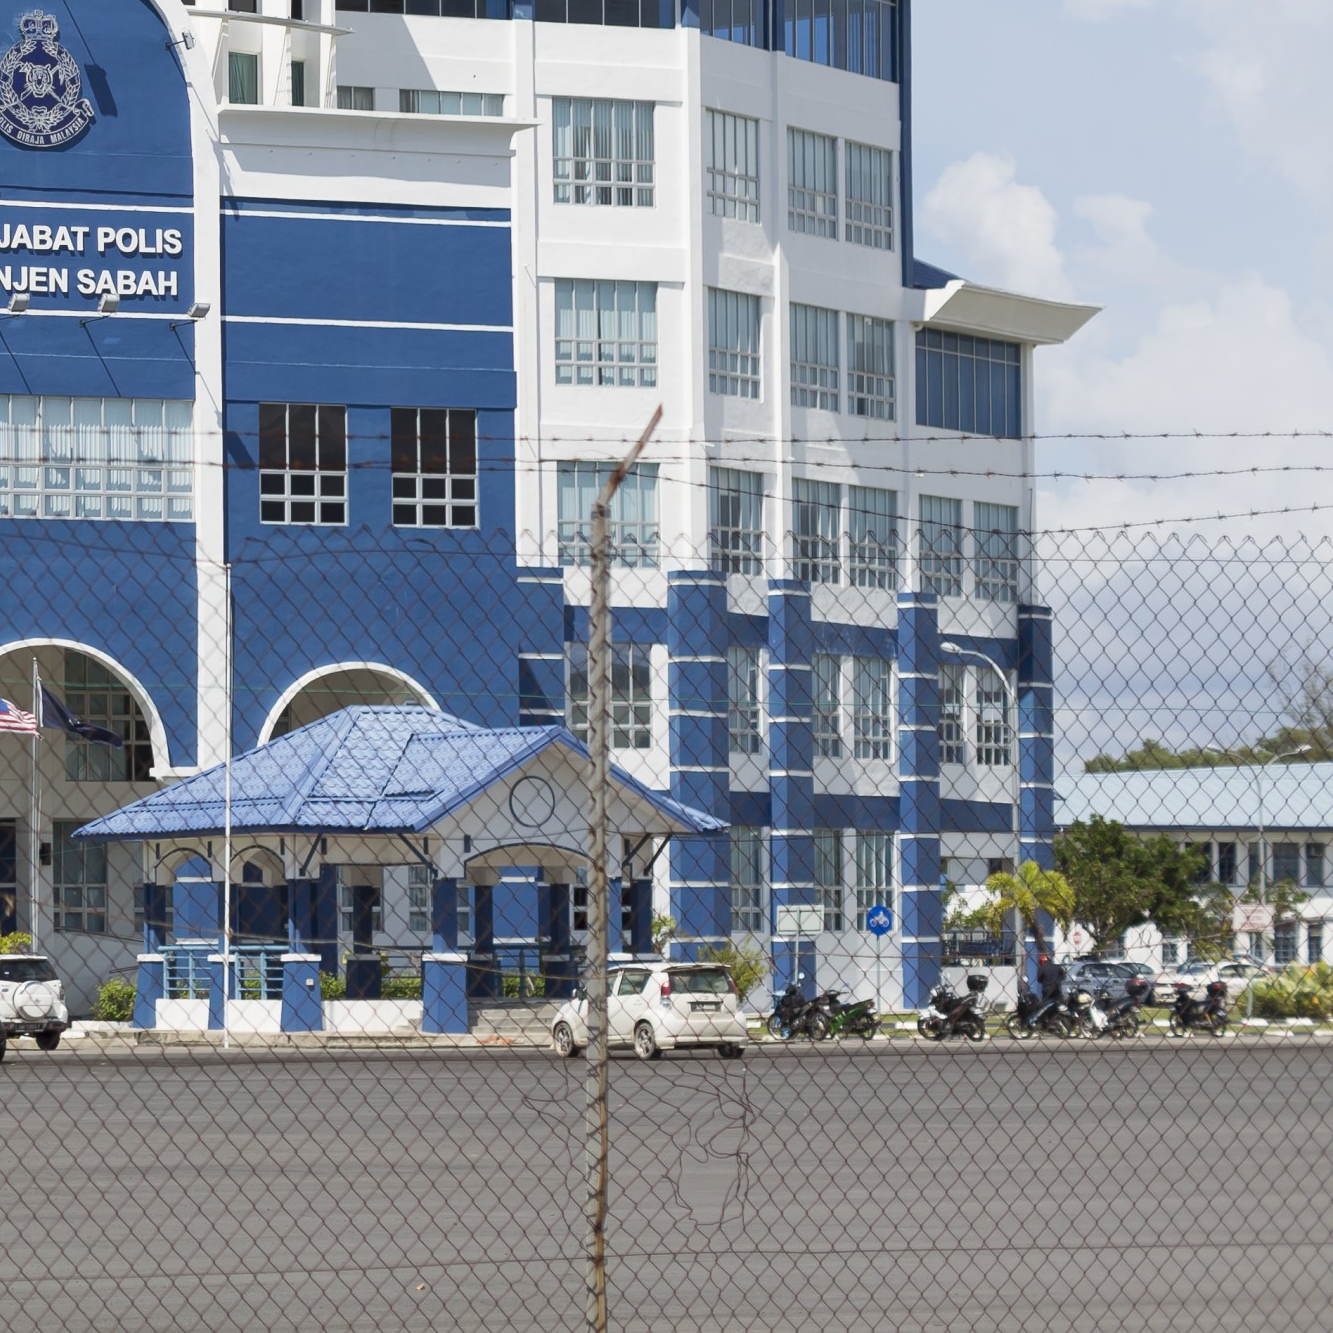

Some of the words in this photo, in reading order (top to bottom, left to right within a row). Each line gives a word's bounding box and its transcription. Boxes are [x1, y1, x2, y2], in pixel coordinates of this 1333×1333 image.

[16, 131, 45, 145] DIRAJA
[50, 117, 85, 144] MALAYSIA
[97, 226, 183, 255] POLIS
[76, 268, 178, 297] SABAH
